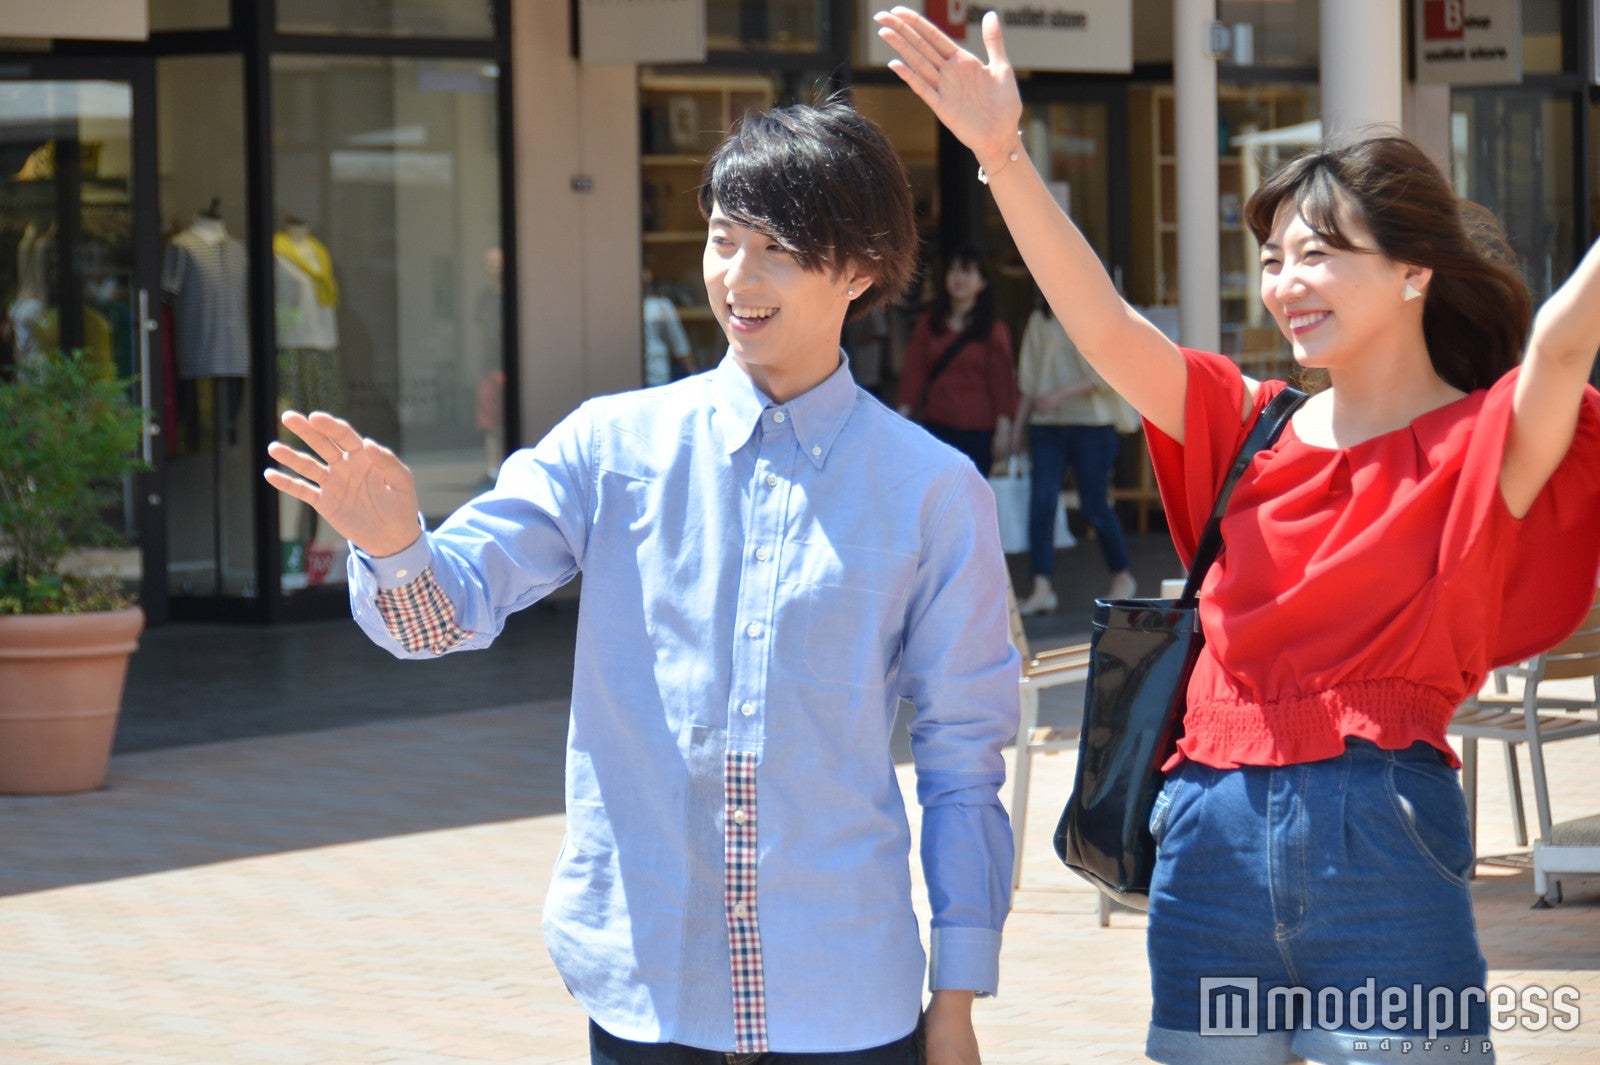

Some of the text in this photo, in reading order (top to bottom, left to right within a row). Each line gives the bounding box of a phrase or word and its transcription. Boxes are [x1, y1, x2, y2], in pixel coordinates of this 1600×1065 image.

[1050, 9, 1087, 28] store
[1425, 45, 1507, 62] outlet store
